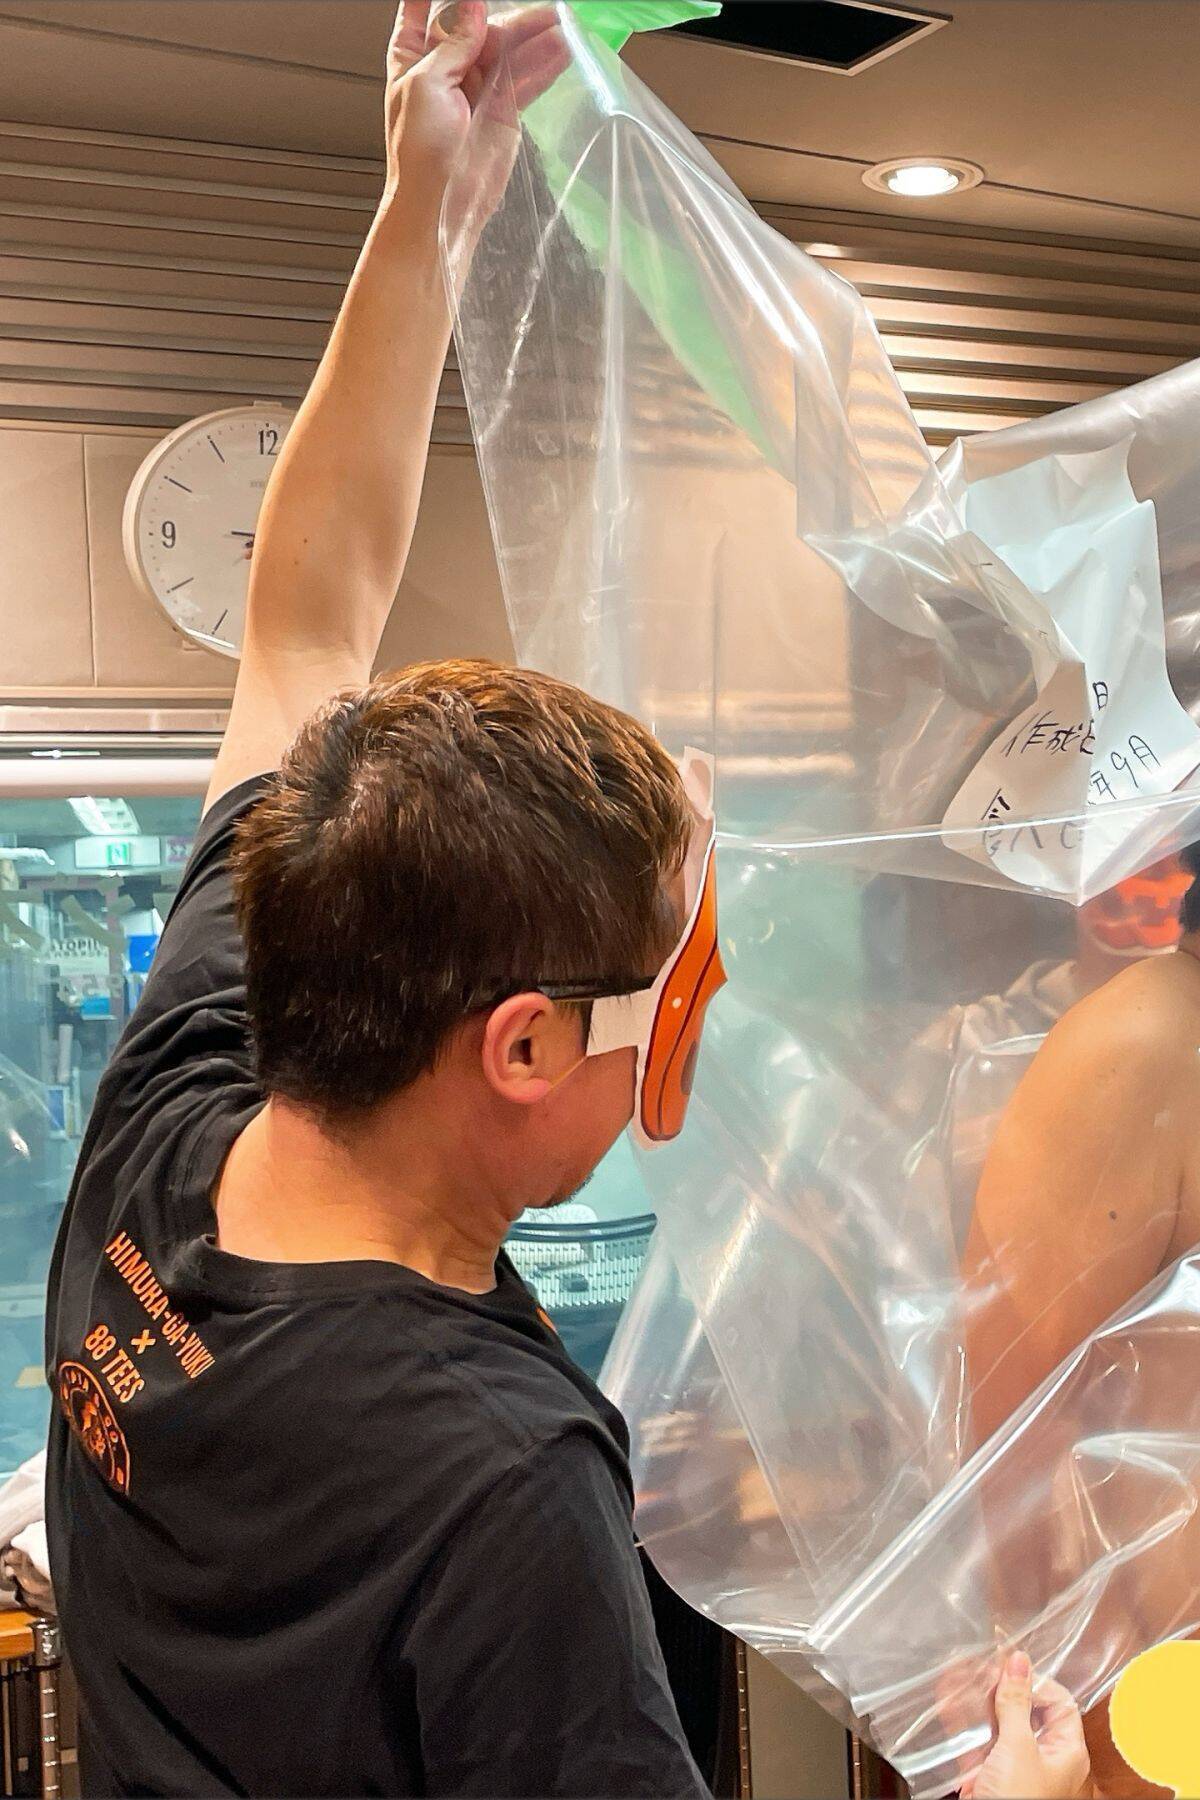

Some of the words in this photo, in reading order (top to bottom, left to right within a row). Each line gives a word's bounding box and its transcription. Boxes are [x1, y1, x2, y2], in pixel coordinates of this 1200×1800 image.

[258, 429, 279, 456] 12
[161, 520, 176, 549] 9
[84, 1324, 117, 1362] 88
[100, 1349, 145, 1404] TEES
